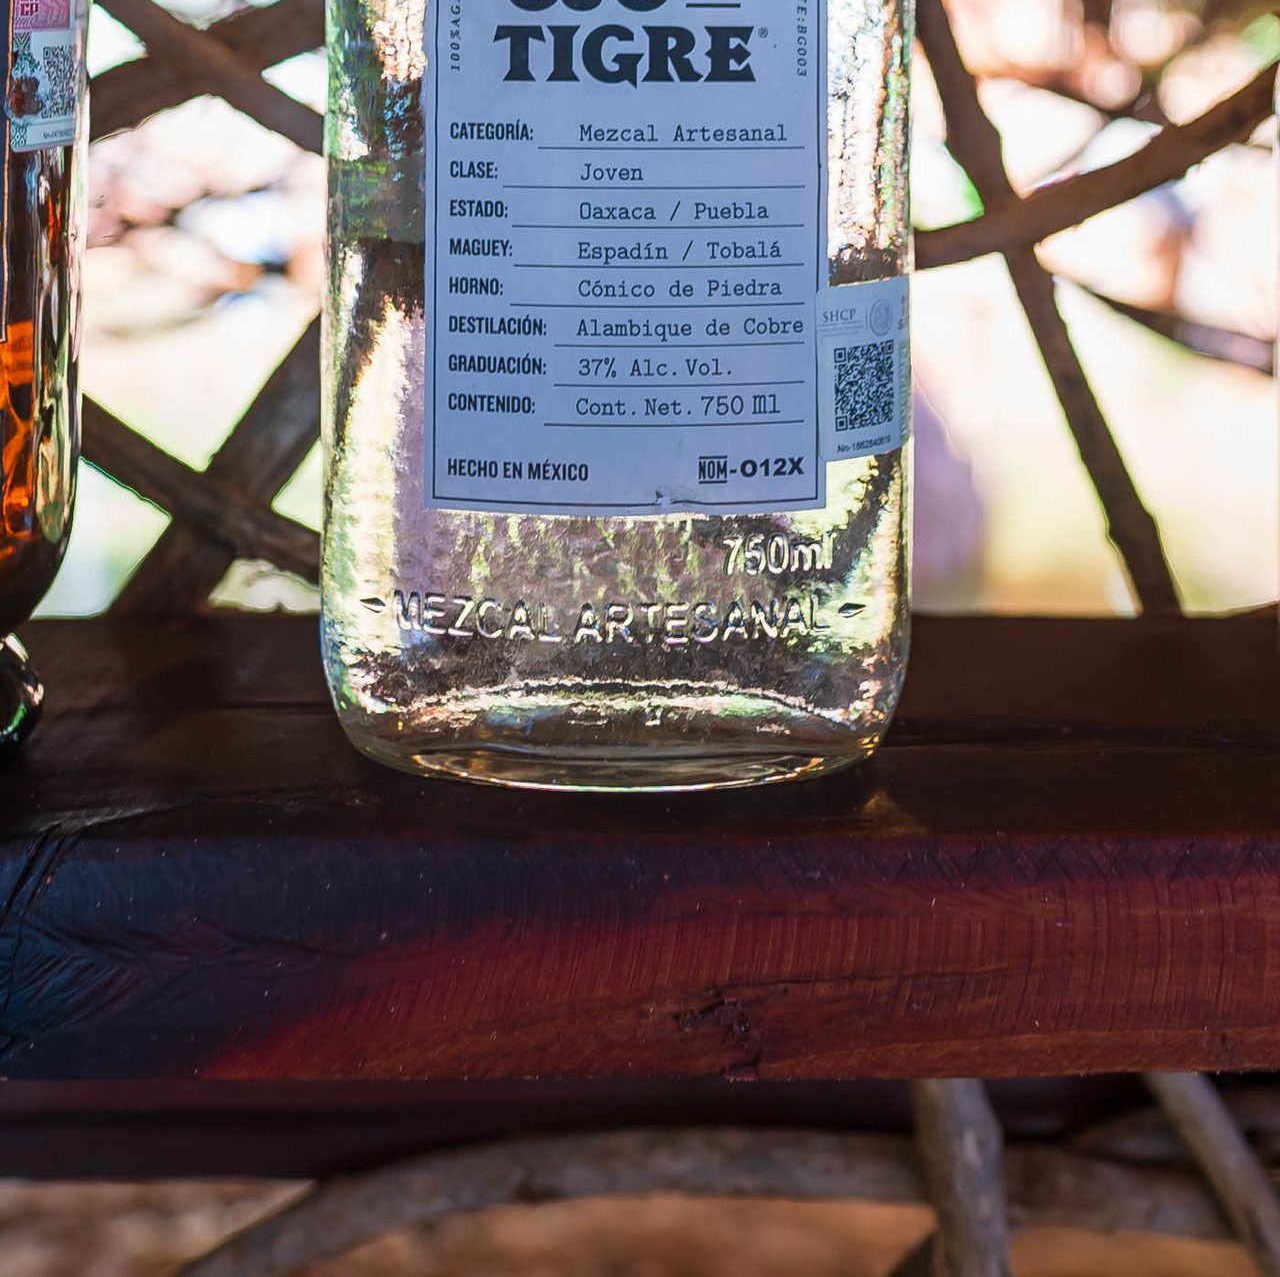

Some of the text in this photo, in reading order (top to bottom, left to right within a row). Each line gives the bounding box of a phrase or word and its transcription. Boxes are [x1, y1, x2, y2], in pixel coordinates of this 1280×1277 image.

[449, 119, 787, 142] CATEGORÍA: Mezcal Artesanal
[449, 160, 644, 182] CLASE: Joven
[449, 199, 508, 218] ESTADO:
[579, 202, 657, 220] Oaxaca
[694, 202, 769, 220] Puebla
[449, 238, 513, 257] MAGUEY:
[577, 242, 669, 265] Espadín
[707, 241, 782, 259] Tobalá
[448, 277, 783, 298] HORNO: Cónico de Piedra
[448, 314, 547, 336] DESTILACIÓN:
[576, 319, 693, 342] Alambique
[706, 319, 731, 337] de
[743, 317, 804, 335] Cobre
[448, 353, 547, 375] GRADUACIÓN:
[578, 357, 617, 379] 37%
[448, 392, 536, 414] CONTENIDO:
[701, 395, 744, 416] 750
[448, 458, 589, 482] HECHO EN MÉXICO
[393, 587, 829, 646] MEZCAL ARTESANAL
